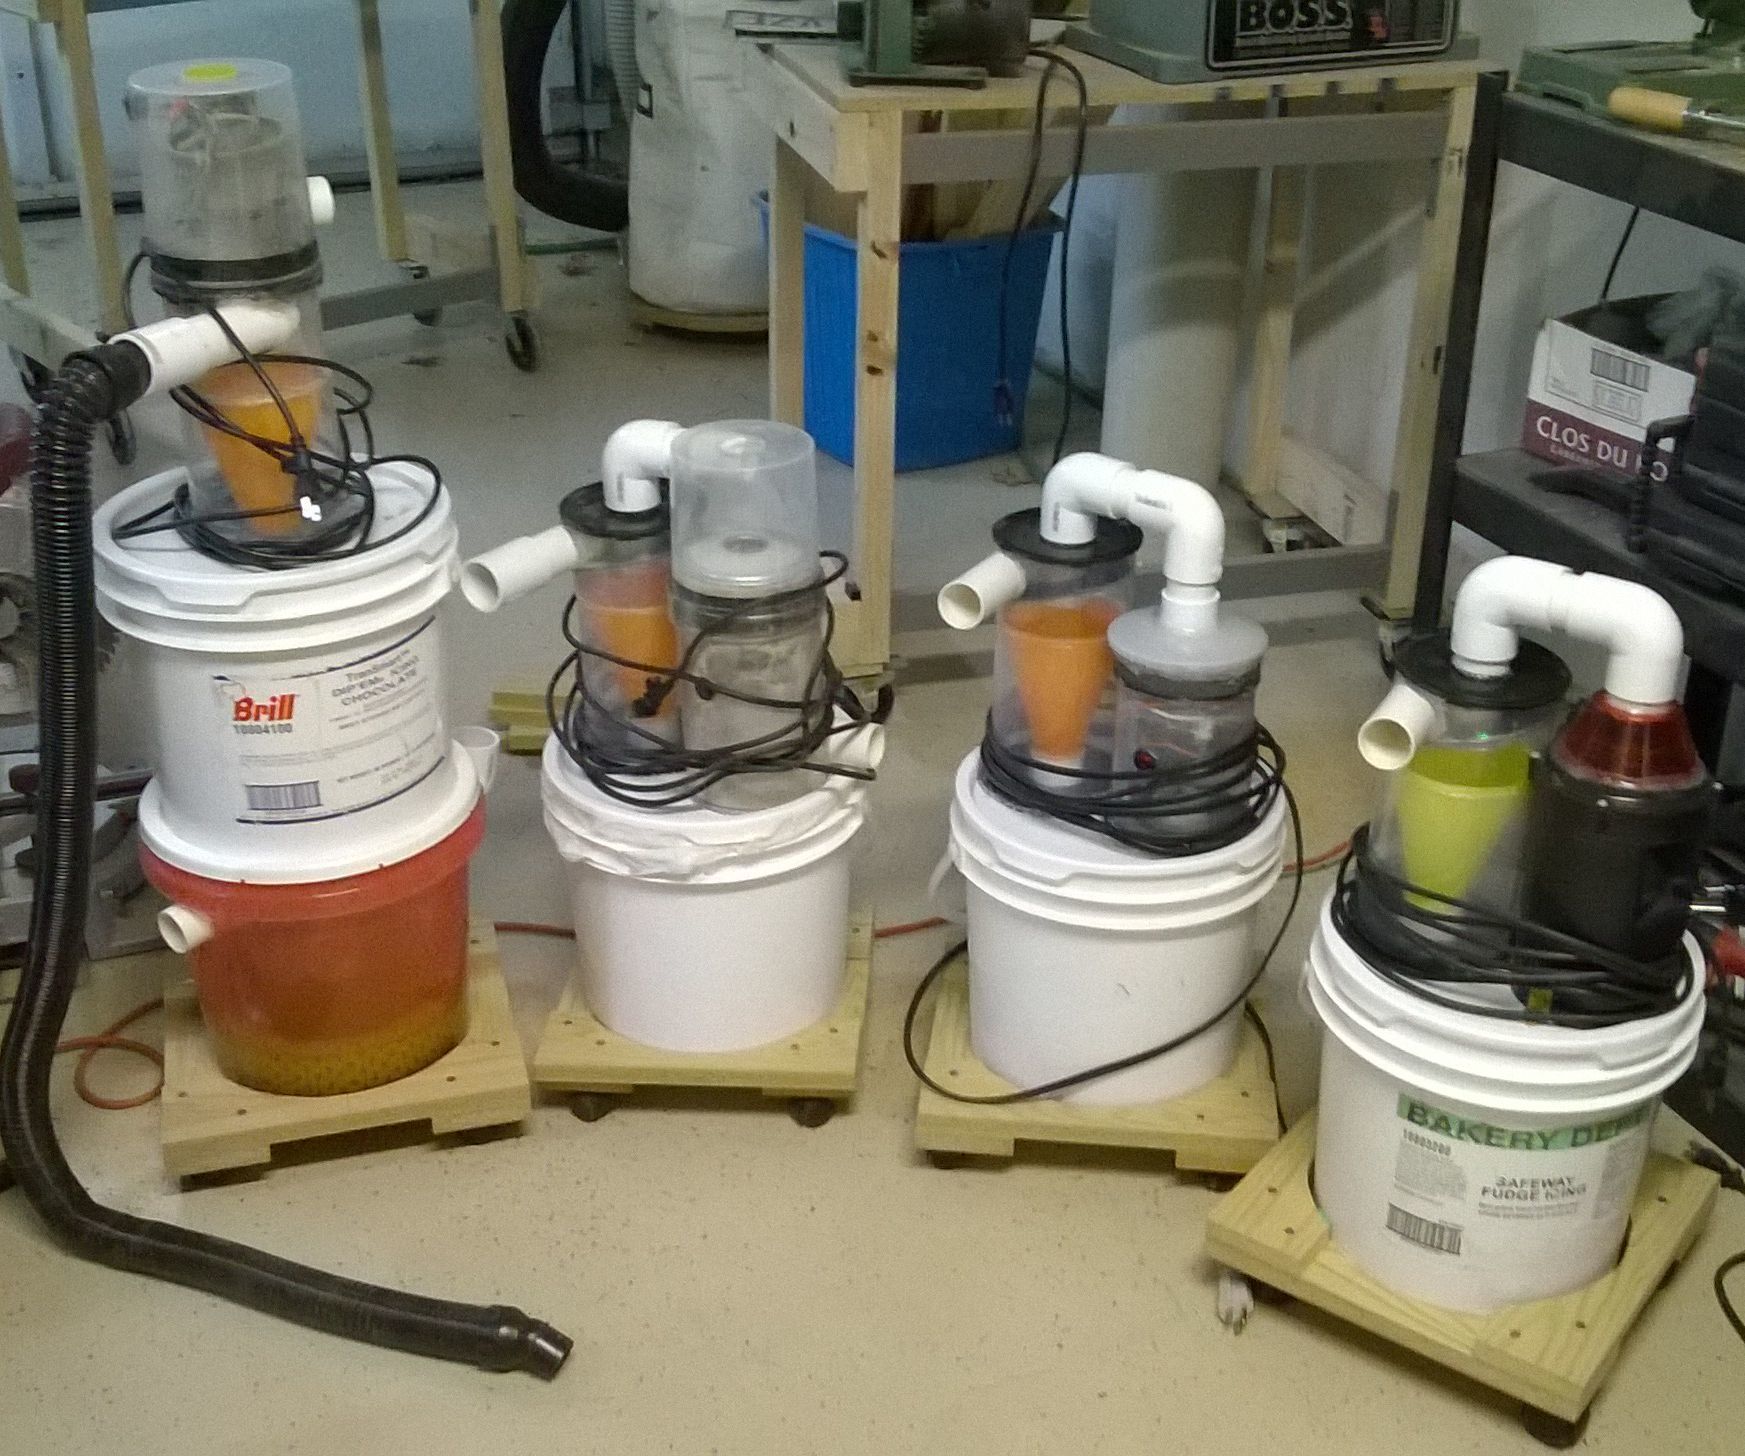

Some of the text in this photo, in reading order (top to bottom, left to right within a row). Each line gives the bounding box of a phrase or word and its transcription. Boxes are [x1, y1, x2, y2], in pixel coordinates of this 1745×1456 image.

[1235, 0, 1353, 35] BOSS
[1536, 415, 1591, 453] CLOS
[1596, 440, 1628, 469] DU
[233, 694, 295, 721] Brill
[1408, 1099, 1560, 1150] BAKERY
[1481, 1185, 1540, 1201] FUDGE
[1495, 1176, 1576, 1189] SAFEWAY
